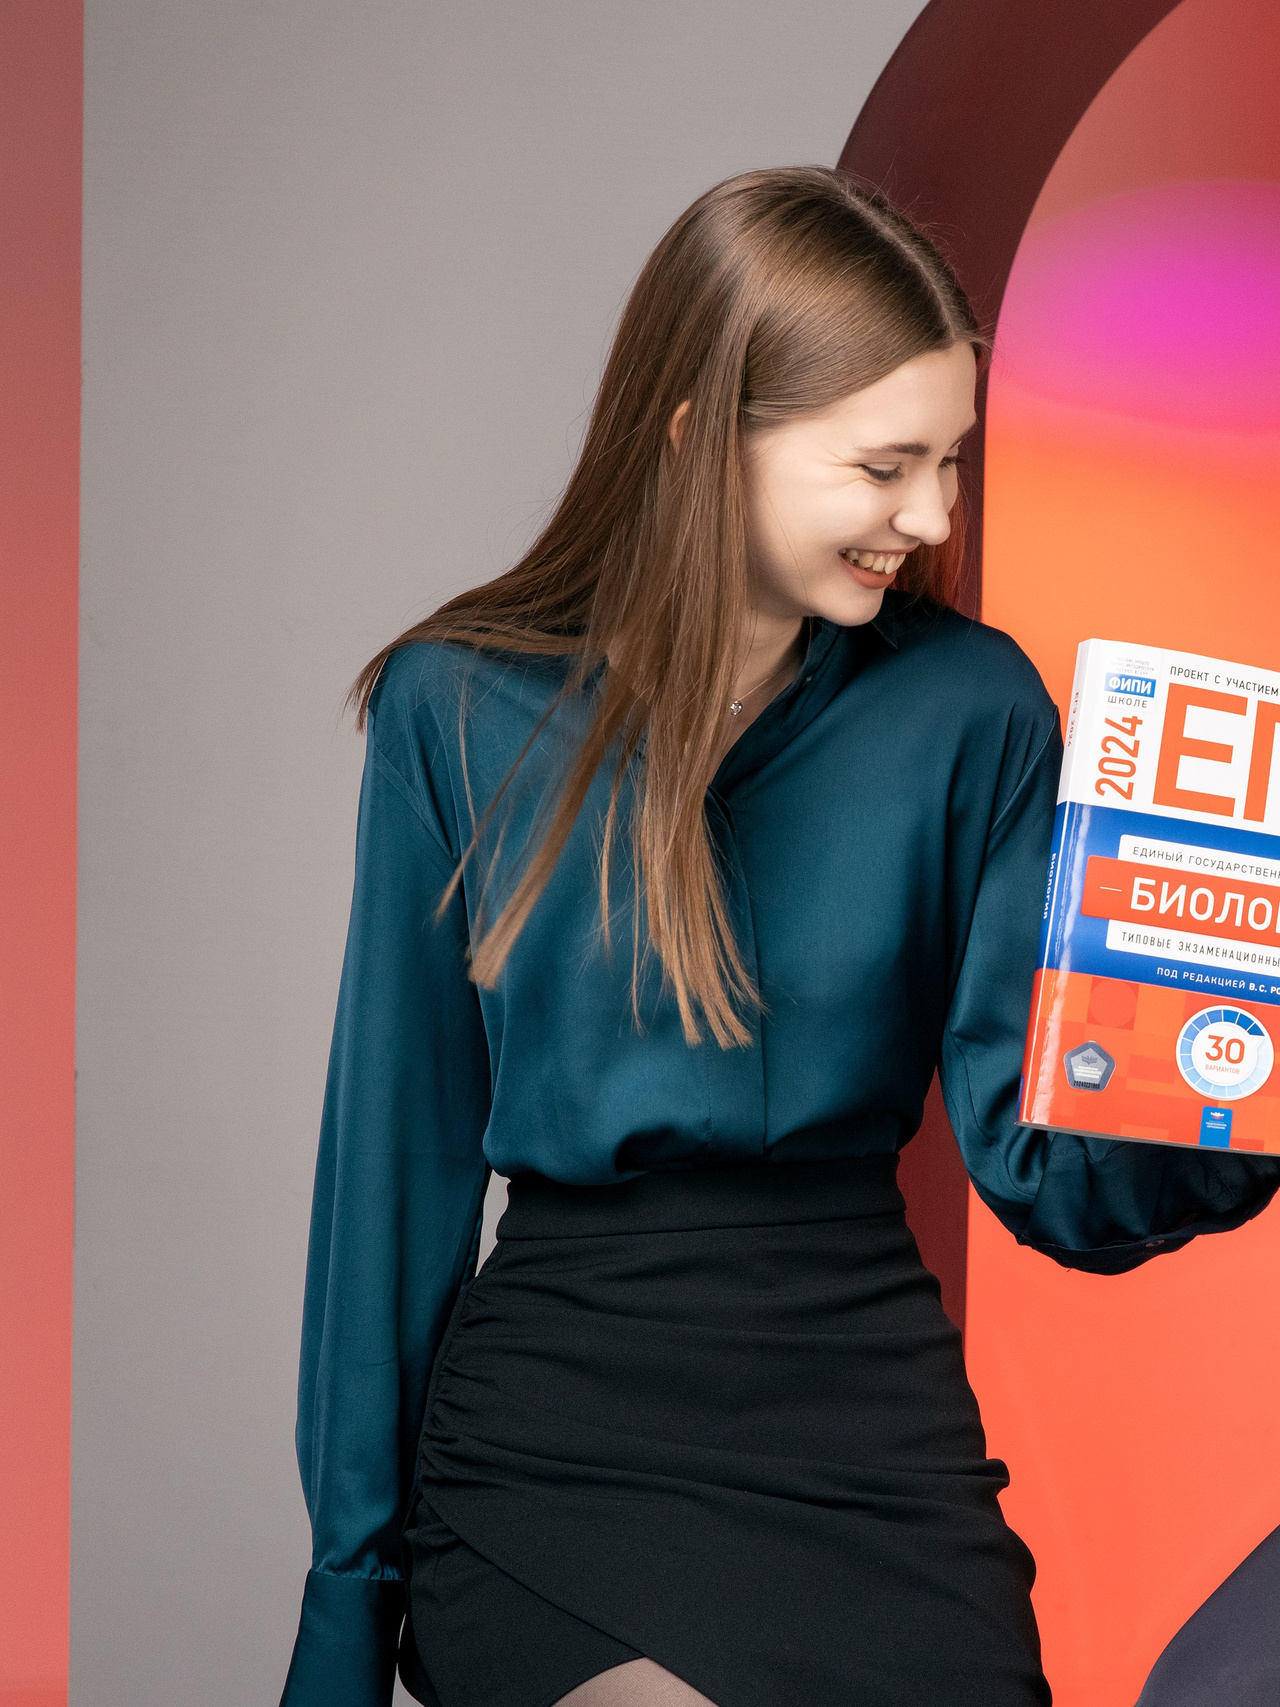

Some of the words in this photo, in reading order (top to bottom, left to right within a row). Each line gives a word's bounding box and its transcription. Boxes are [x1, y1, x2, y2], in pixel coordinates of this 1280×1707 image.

[1109, 676, 1152, 695] ФИПИ
[1169, 666, 1209, 682] ПРОЕКТ
[1214, 675, 1221, 684] С
[1226, 677, 1279, 697] УЧАСТИЕМ
[1107, 695, 1148, 708] ШКОЛЕ
[1094, 715, 1143, 801] 2024
[1132, 846, 1183, 863] ЕДИНЫЙ
[1043, 852, 1057, 919] БИОЛОГИЯ
[1121, 932, 1171, 949] ТИПОВЫЕ
[1156, 967, 1178, 979] ПОД
[1182, 971, 1246, 990] РЕДАКЦИЕЙ
[1205, 1034, 1246, 1065] 30
[1204, 1064, 1240, 1075] ВАРИАНТОВ
